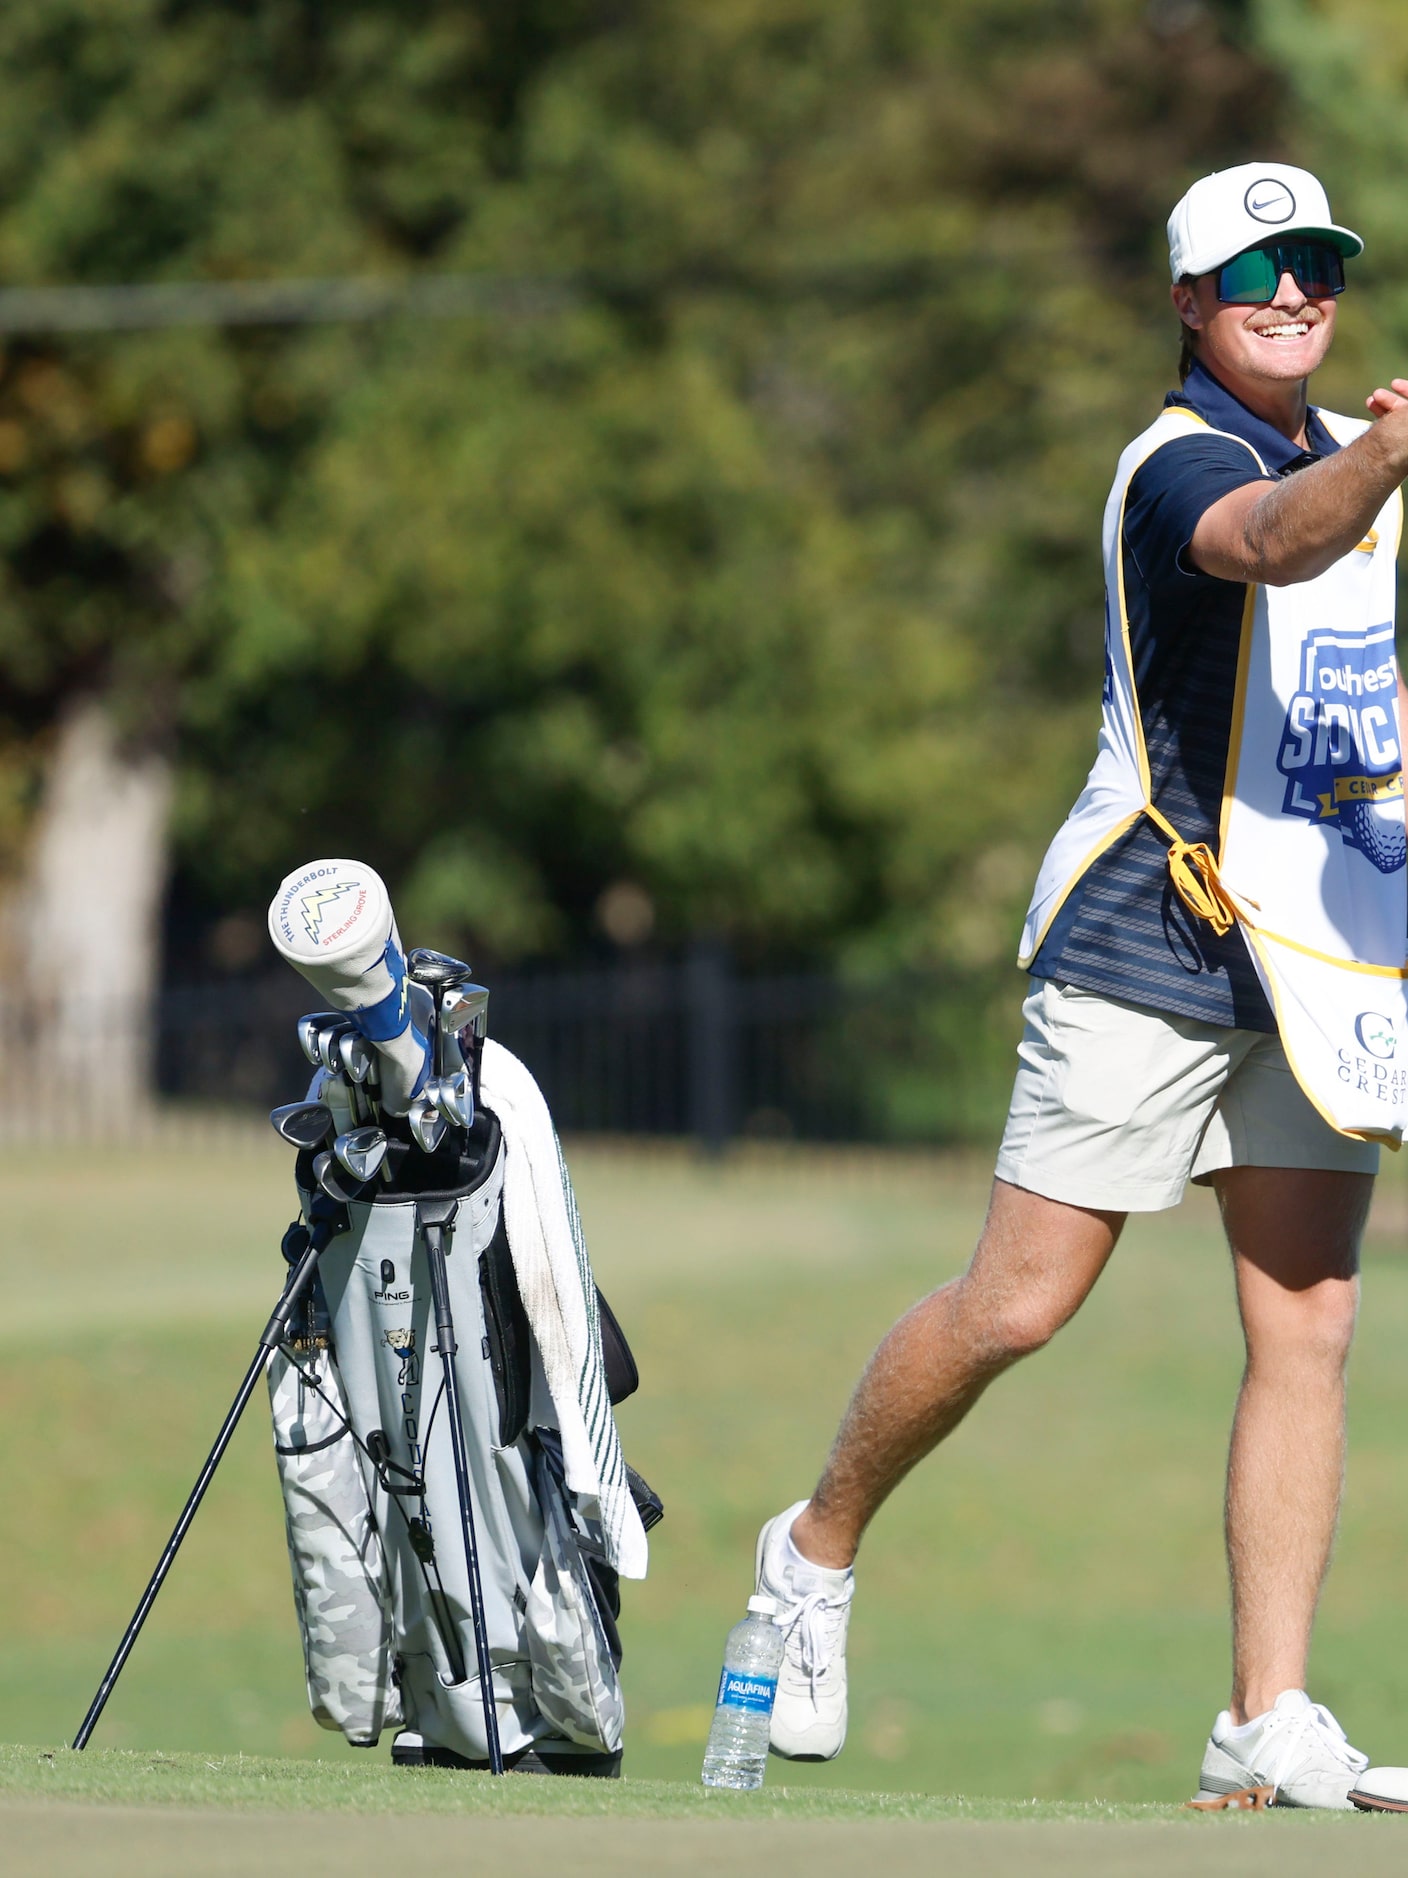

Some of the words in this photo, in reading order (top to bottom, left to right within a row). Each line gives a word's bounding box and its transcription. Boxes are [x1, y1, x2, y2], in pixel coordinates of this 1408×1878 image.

[280, 867, 338, 922] THUNDERBOLT
[281, 922, 295, 943] THE
[322, 915, 358, 946] STERLING
[354, 889, 367, 916] GROVE
[1337, 1047, 1407, 1086] CEDAR
[1337, 1065, 1407, 1105] CREST
[374, 1291, 410, 1301] PING
[727, 1679, 771, 1699] AQUAFINA
